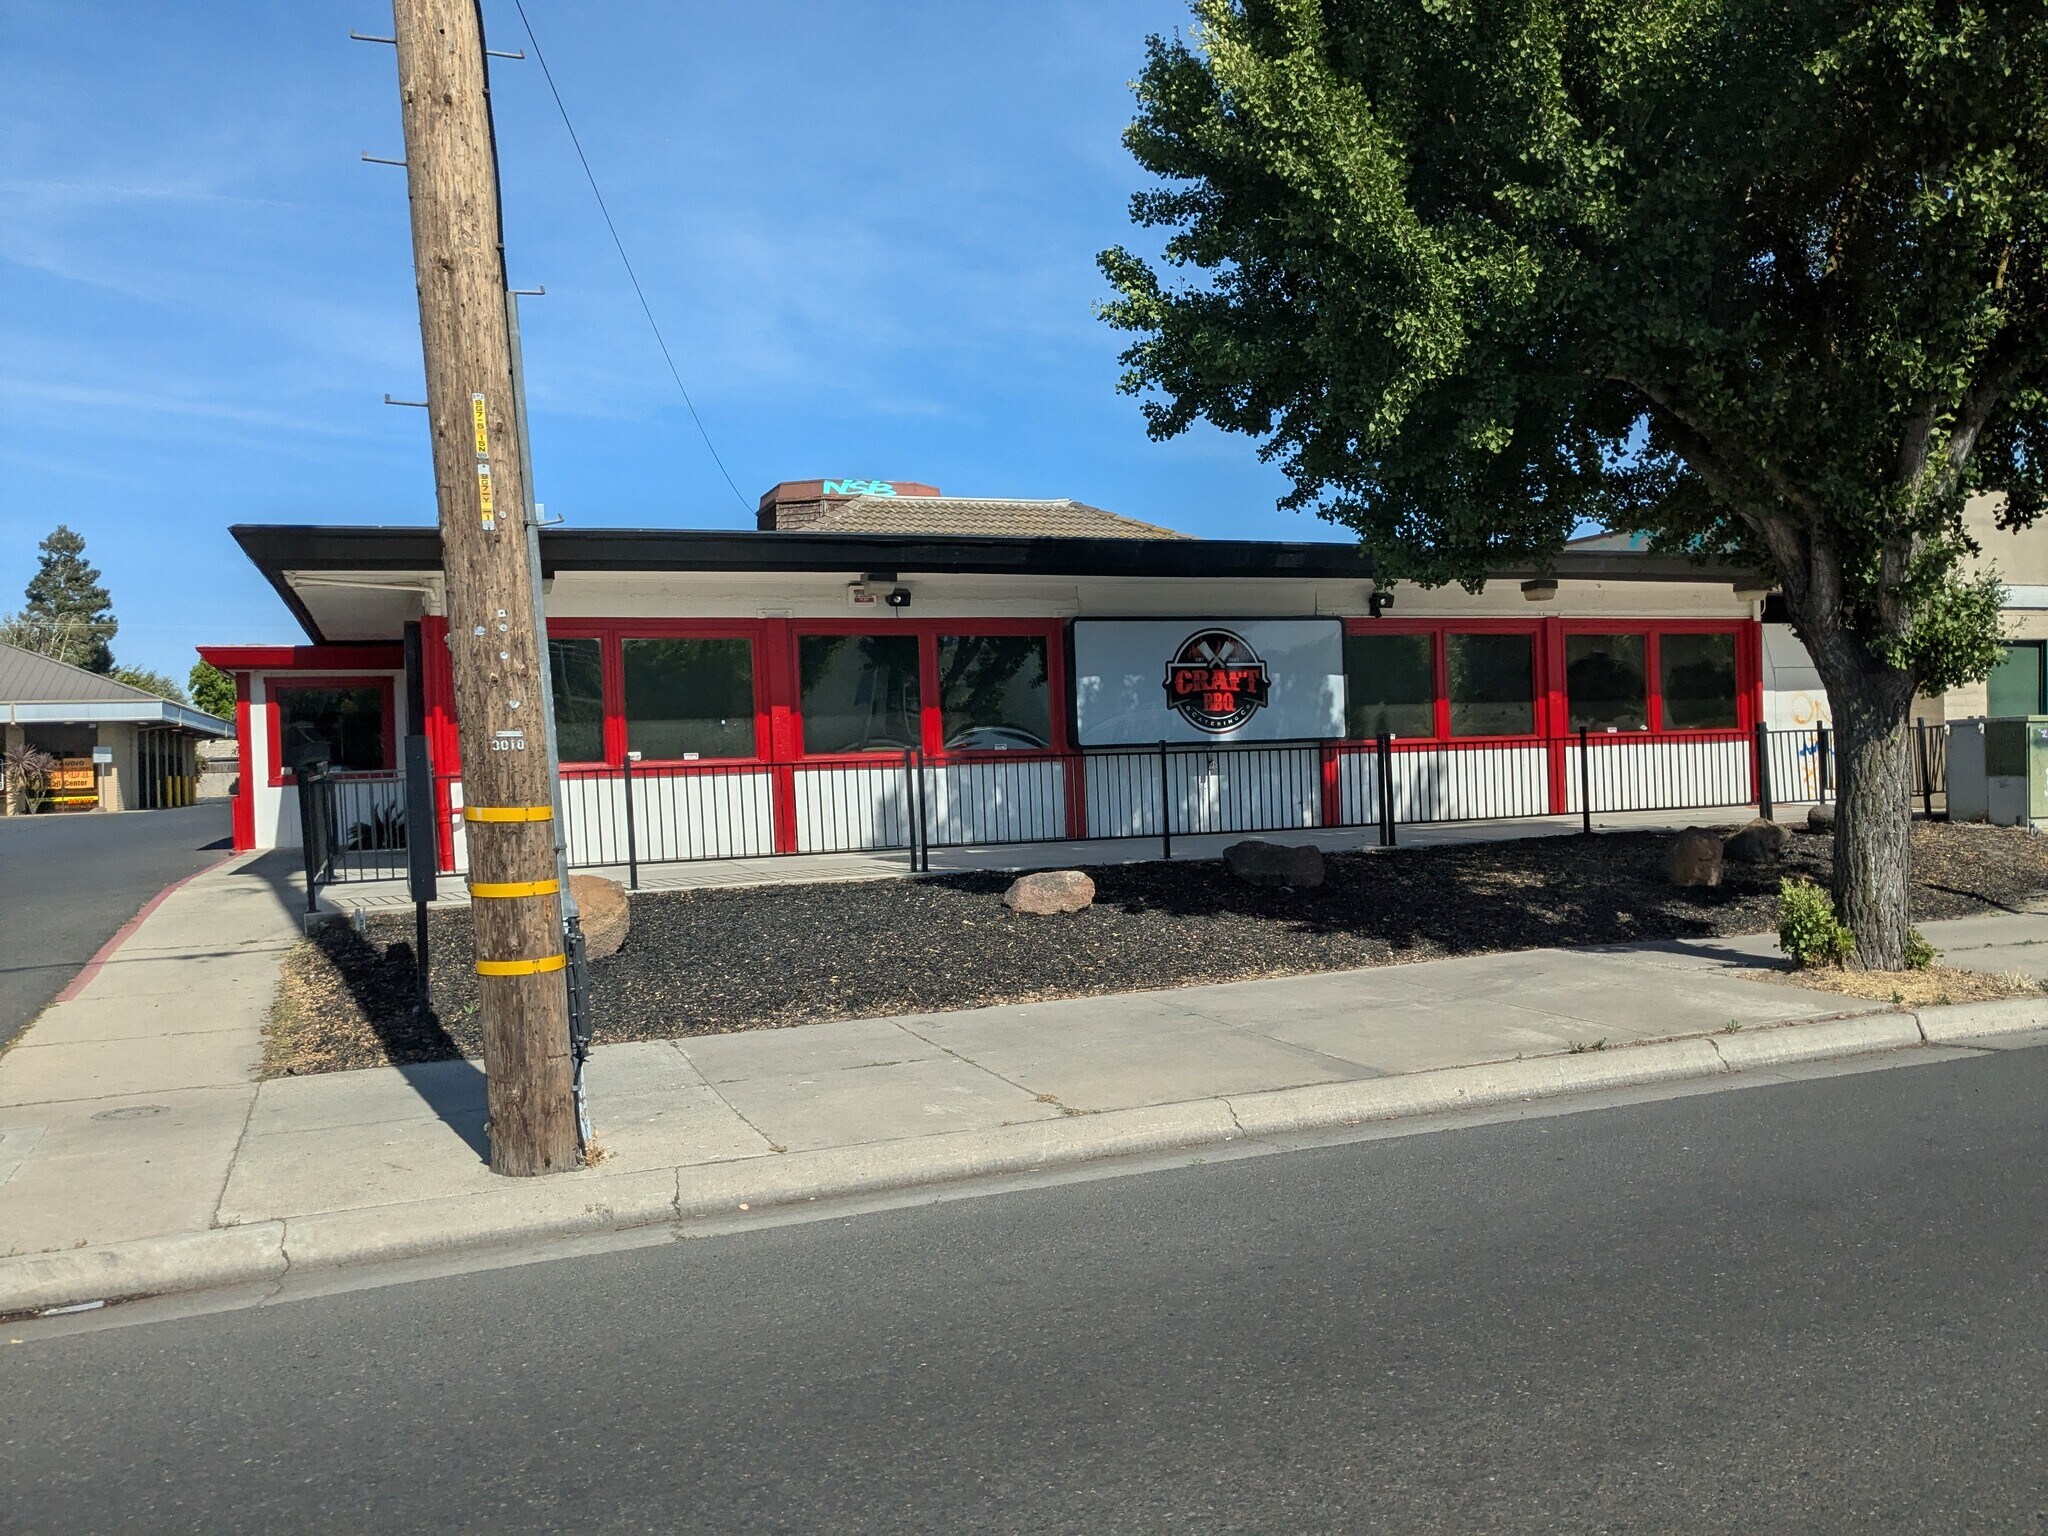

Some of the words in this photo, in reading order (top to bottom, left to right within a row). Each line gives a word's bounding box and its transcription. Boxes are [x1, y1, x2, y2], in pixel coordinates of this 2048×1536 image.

[1175, 669, 1260, 695] CRAFT
[1203, 692, 1236, 712] BBQ
[1192, 712, 1239, 727] CATERING
[492, 739, 525, 751] 3010
